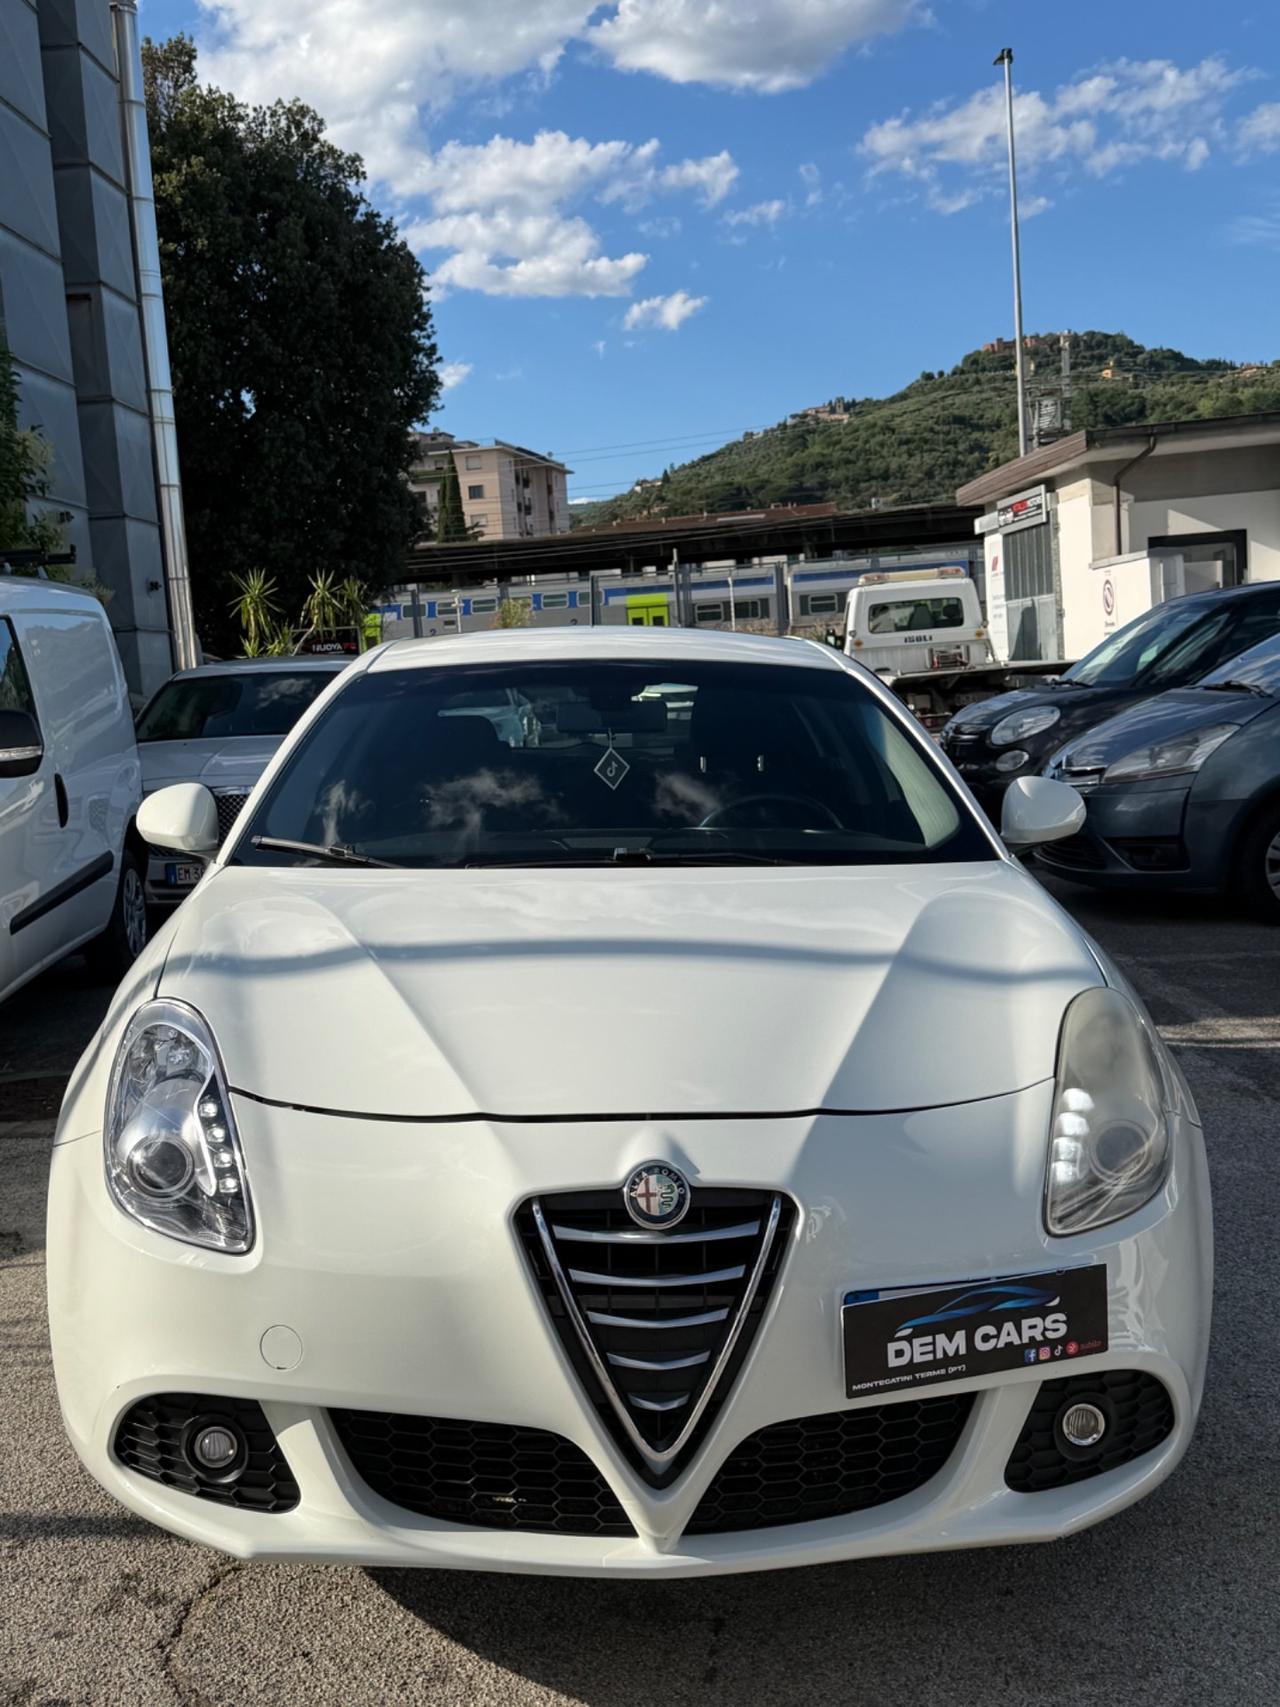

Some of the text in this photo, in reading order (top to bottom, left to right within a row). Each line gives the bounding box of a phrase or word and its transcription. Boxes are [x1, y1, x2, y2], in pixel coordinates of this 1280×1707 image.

[178, 867, 191, 880] EM
[887, 1312, 1067, 1368] DEM CARS
[852, 1364, 966, 1391] MONTECATINI TERME (PT)
